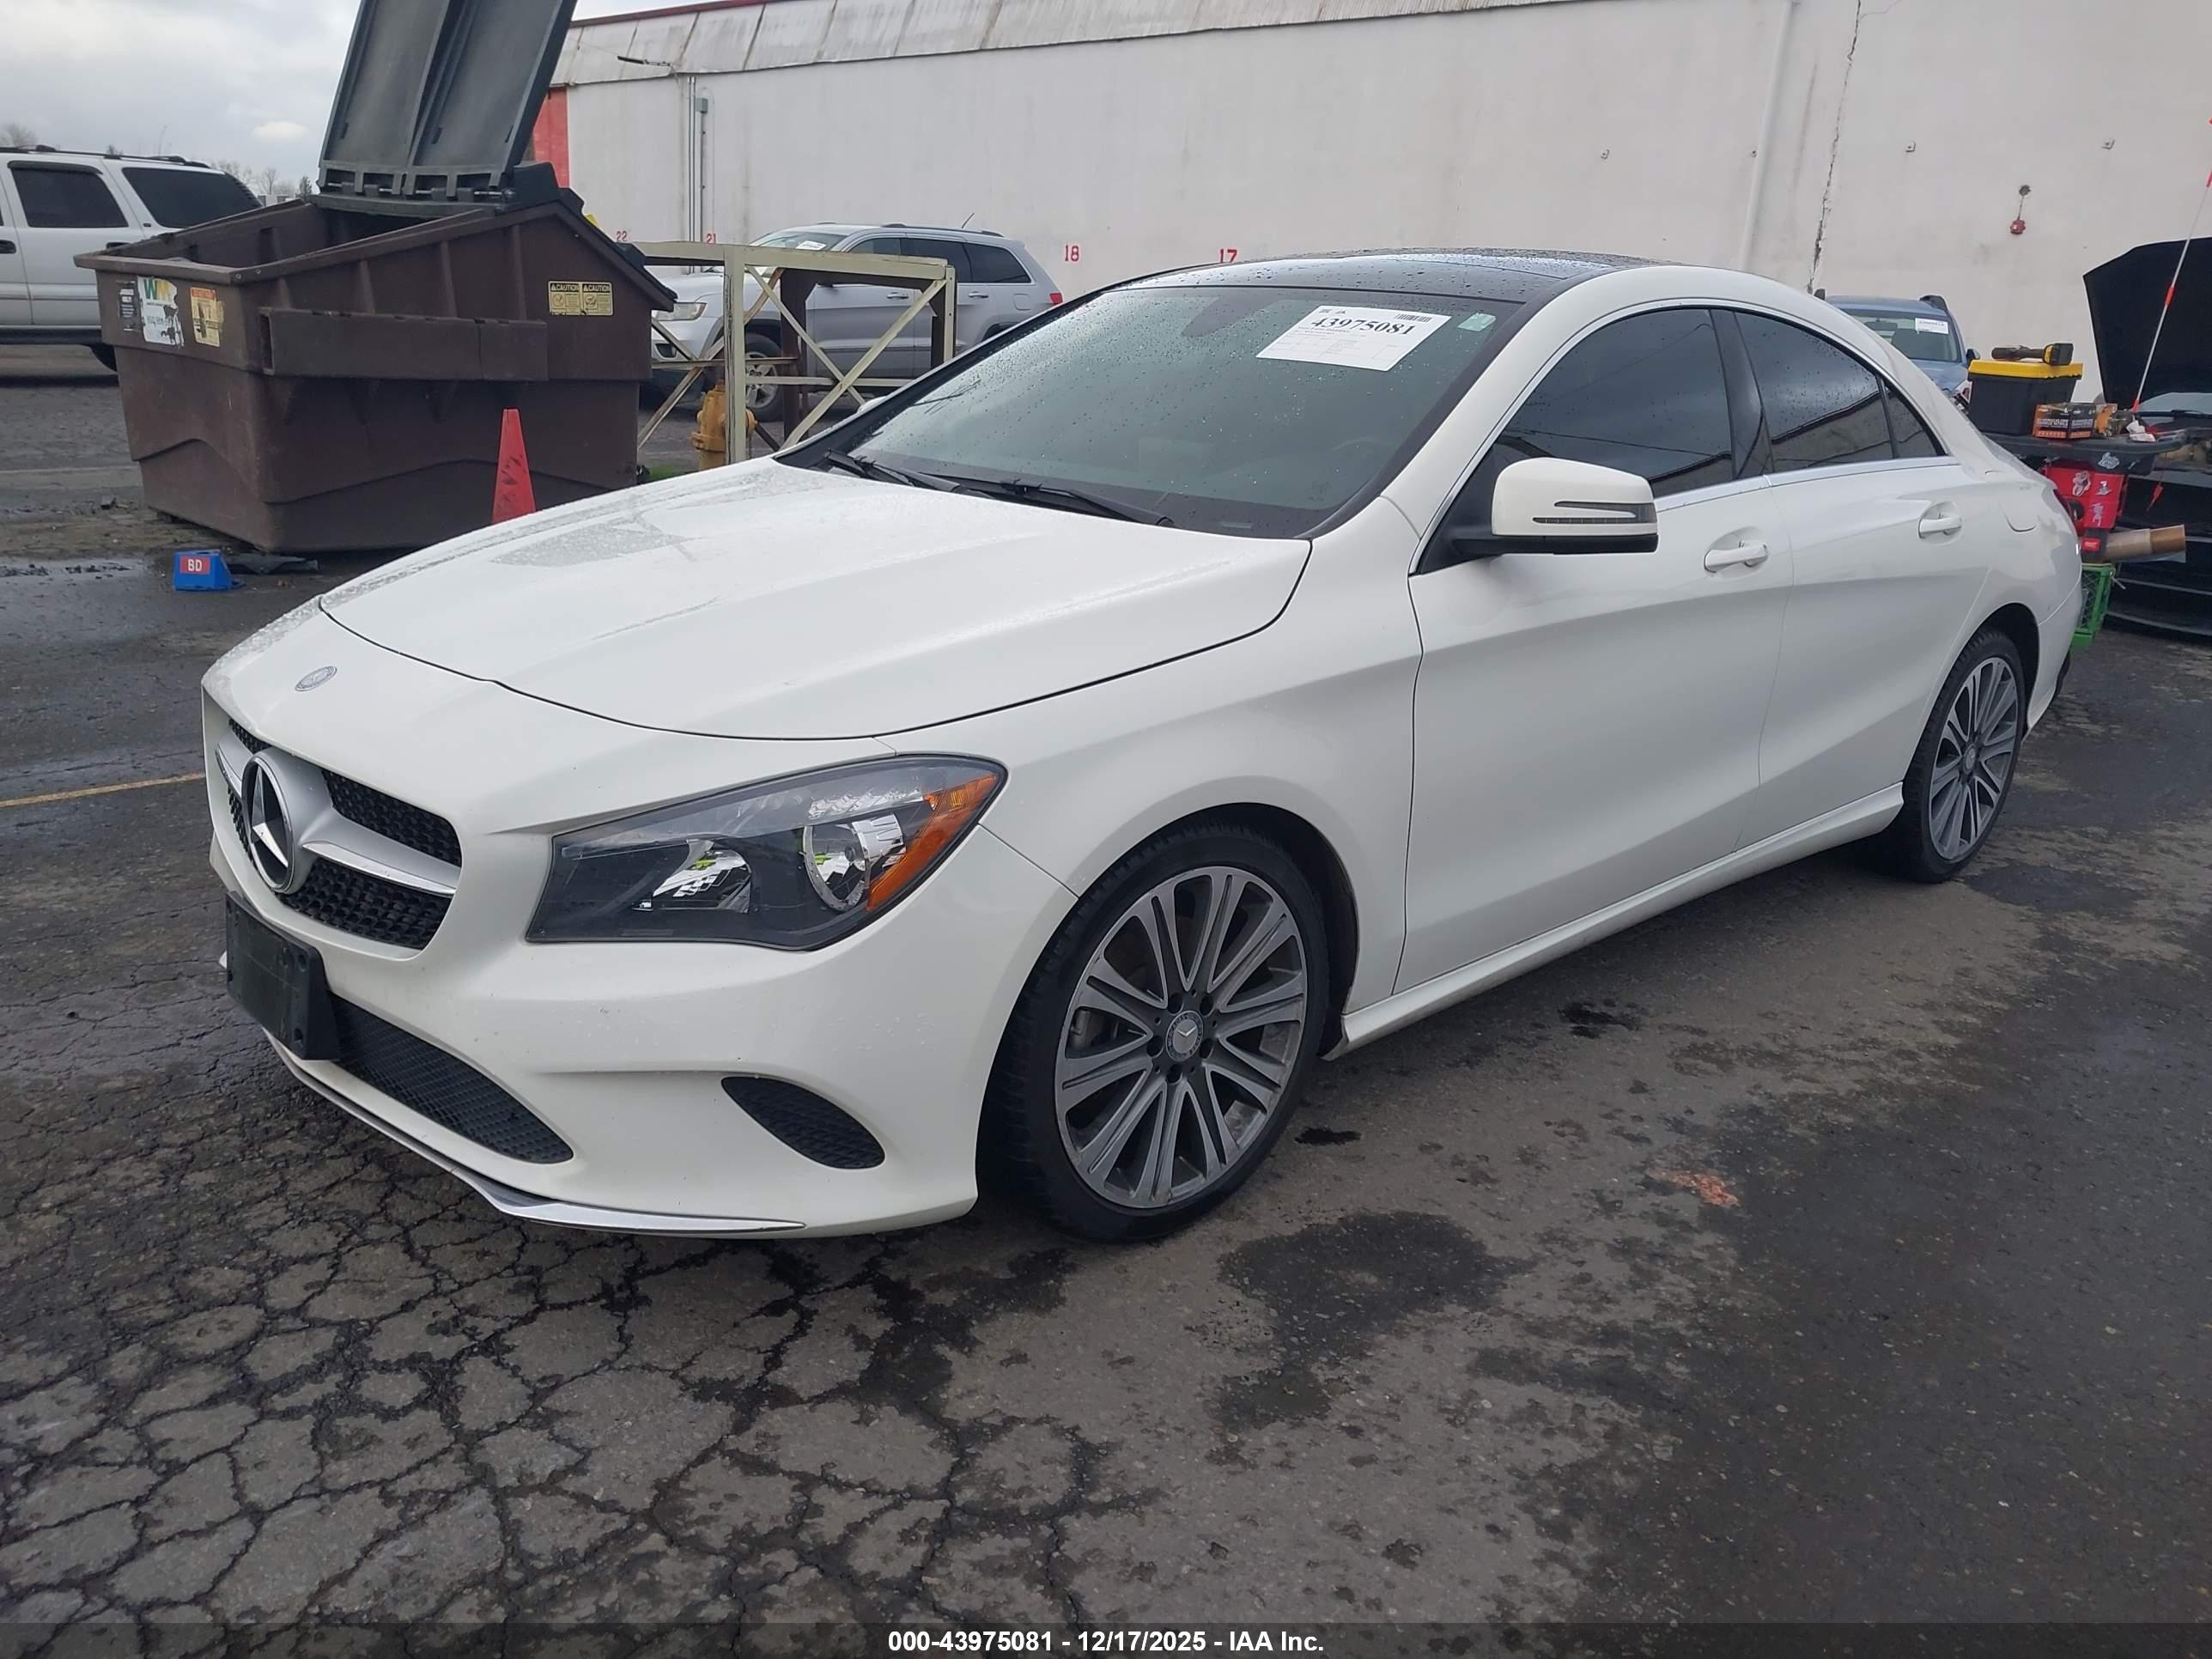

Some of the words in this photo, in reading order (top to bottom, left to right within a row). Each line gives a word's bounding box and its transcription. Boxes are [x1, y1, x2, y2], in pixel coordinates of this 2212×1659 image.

[617, 231, 628, 241] 22
[706, 233, 717, 244] 21
[1065, 245, 1079, 262] 18
[1219, 248, 1237, 263] 17
[1311, 317, 1416, 335] 43975081
[188, 559, 203, 572] BD
